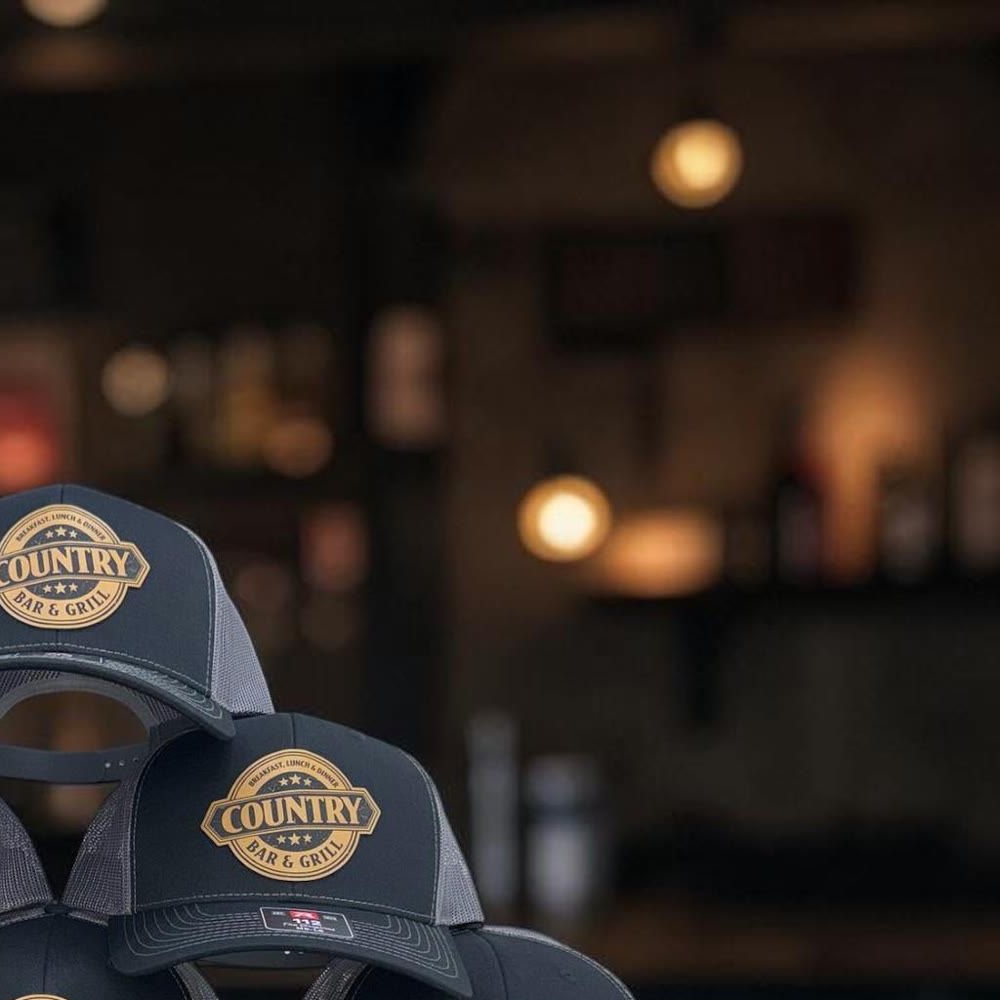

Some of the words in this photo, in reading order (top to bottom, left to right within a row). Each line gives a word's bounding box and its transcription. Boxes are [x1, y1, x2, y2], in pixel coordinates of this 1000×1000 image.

[51, 513, 76, 521] LUNCH
[83, 520, 106, 540] DINNER
[13, 591, 44, 615] BAR
[48, 605, 59, 616] &
[65, 590, 110, 615] GRILL
[286, 760, 310, 769] LUNCH
[317, 767, 339, 788] DINNER
[221, 795, 362, 833] COUNTRY
[246, 840, 277, 865] BAR
[283, 856, 293, 868] &
[300, 840, 343, 867] GRILL
